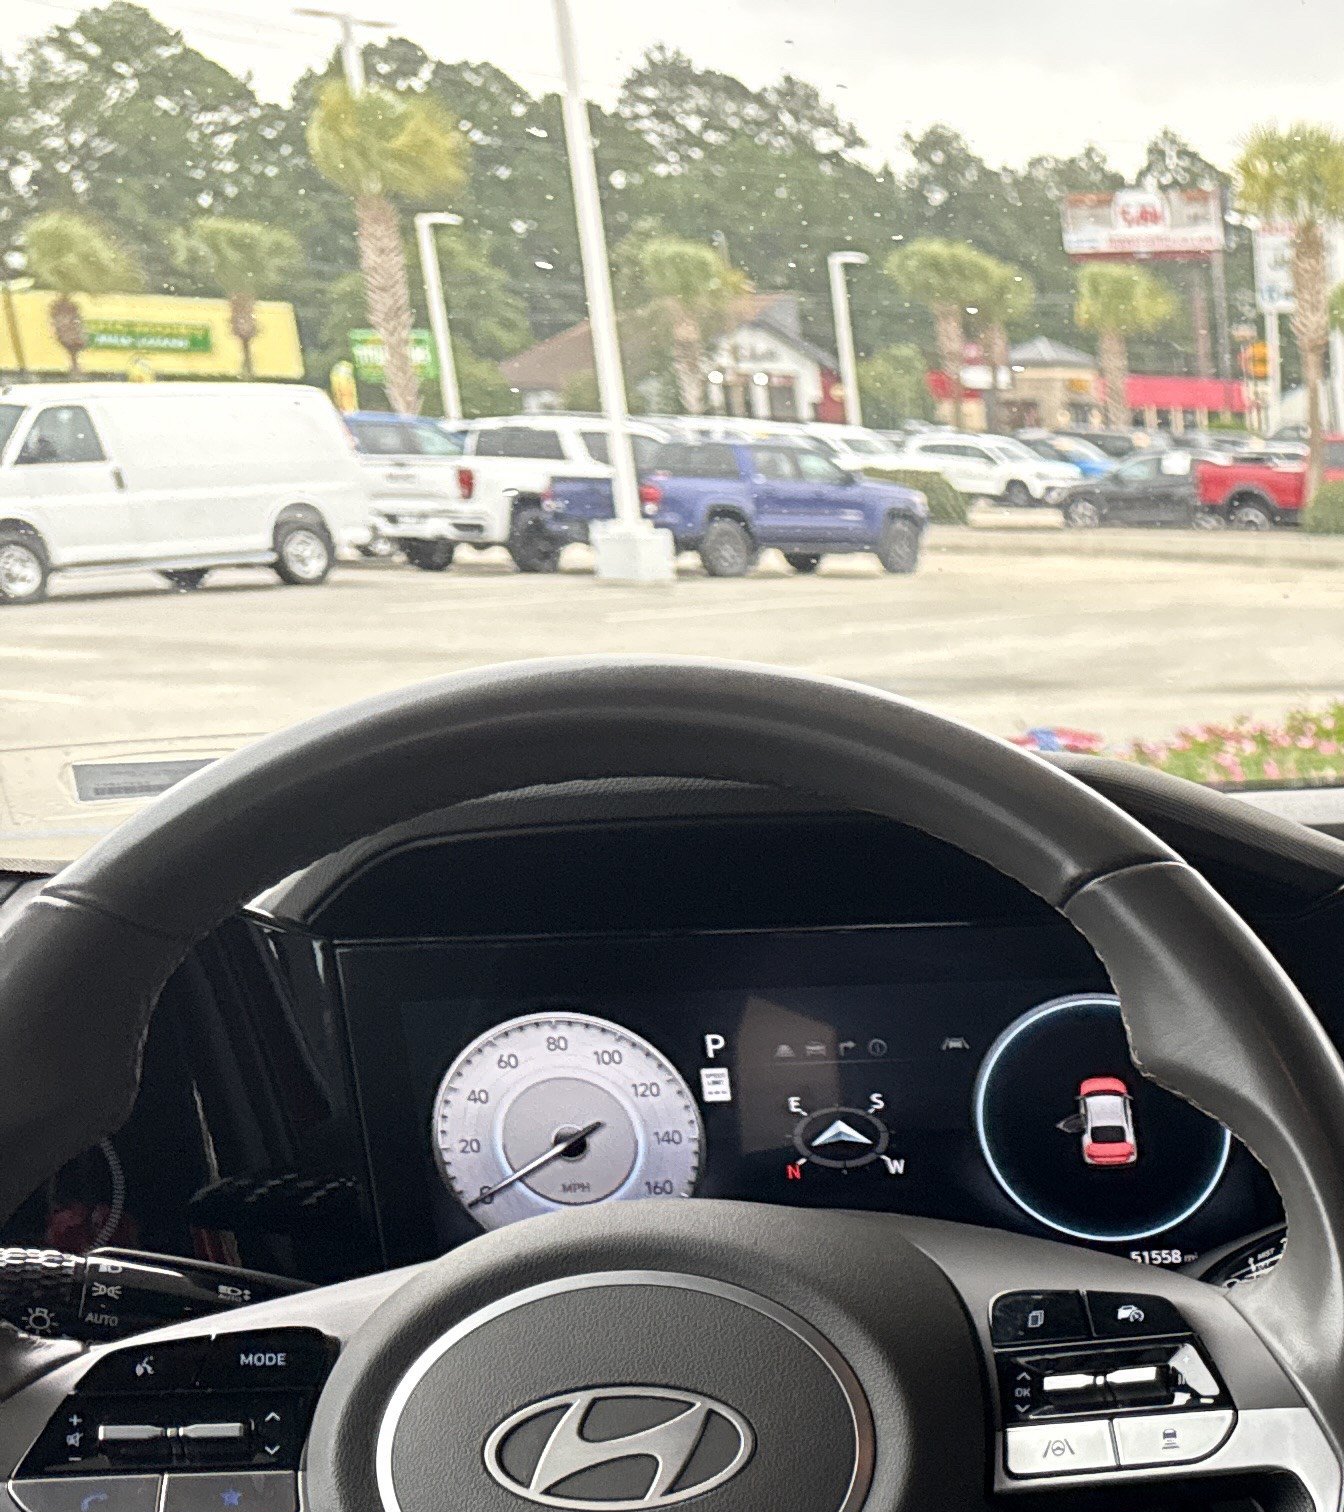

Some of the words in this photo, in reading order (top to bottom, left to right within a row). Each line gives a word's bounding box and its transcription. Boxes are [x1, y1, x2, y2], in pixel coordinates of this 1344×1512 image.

[546, 1036, 568, 1051] 80
[705, 1034, 725, 1058] P
[497, 1053, 519, 1069] 60
[593, 1050, 623, 1065] 100
[467, 1089, 489, 1104] 40
[631, 1082, 661, 1098] 120
[787, 1096, 801, 1112] E
[869, 1093, 885, 1109] S
[653, 1130, 683, 1145] 140
[458, 1138, 480, 1154] 20
[785, 1164, 801, 1180] N
[886, 1159, 905, 1175] W
[561, 1183, 592, 1193] MPH
[644, 1179, 674, 1195] 160
[1130, 1249, 1182, 1264] 51558
[84, 1312, 118, 1327] AUTO
[240, 1352, 287, 1367] MODE
[1014, 1387, 1031, 1397] OK
